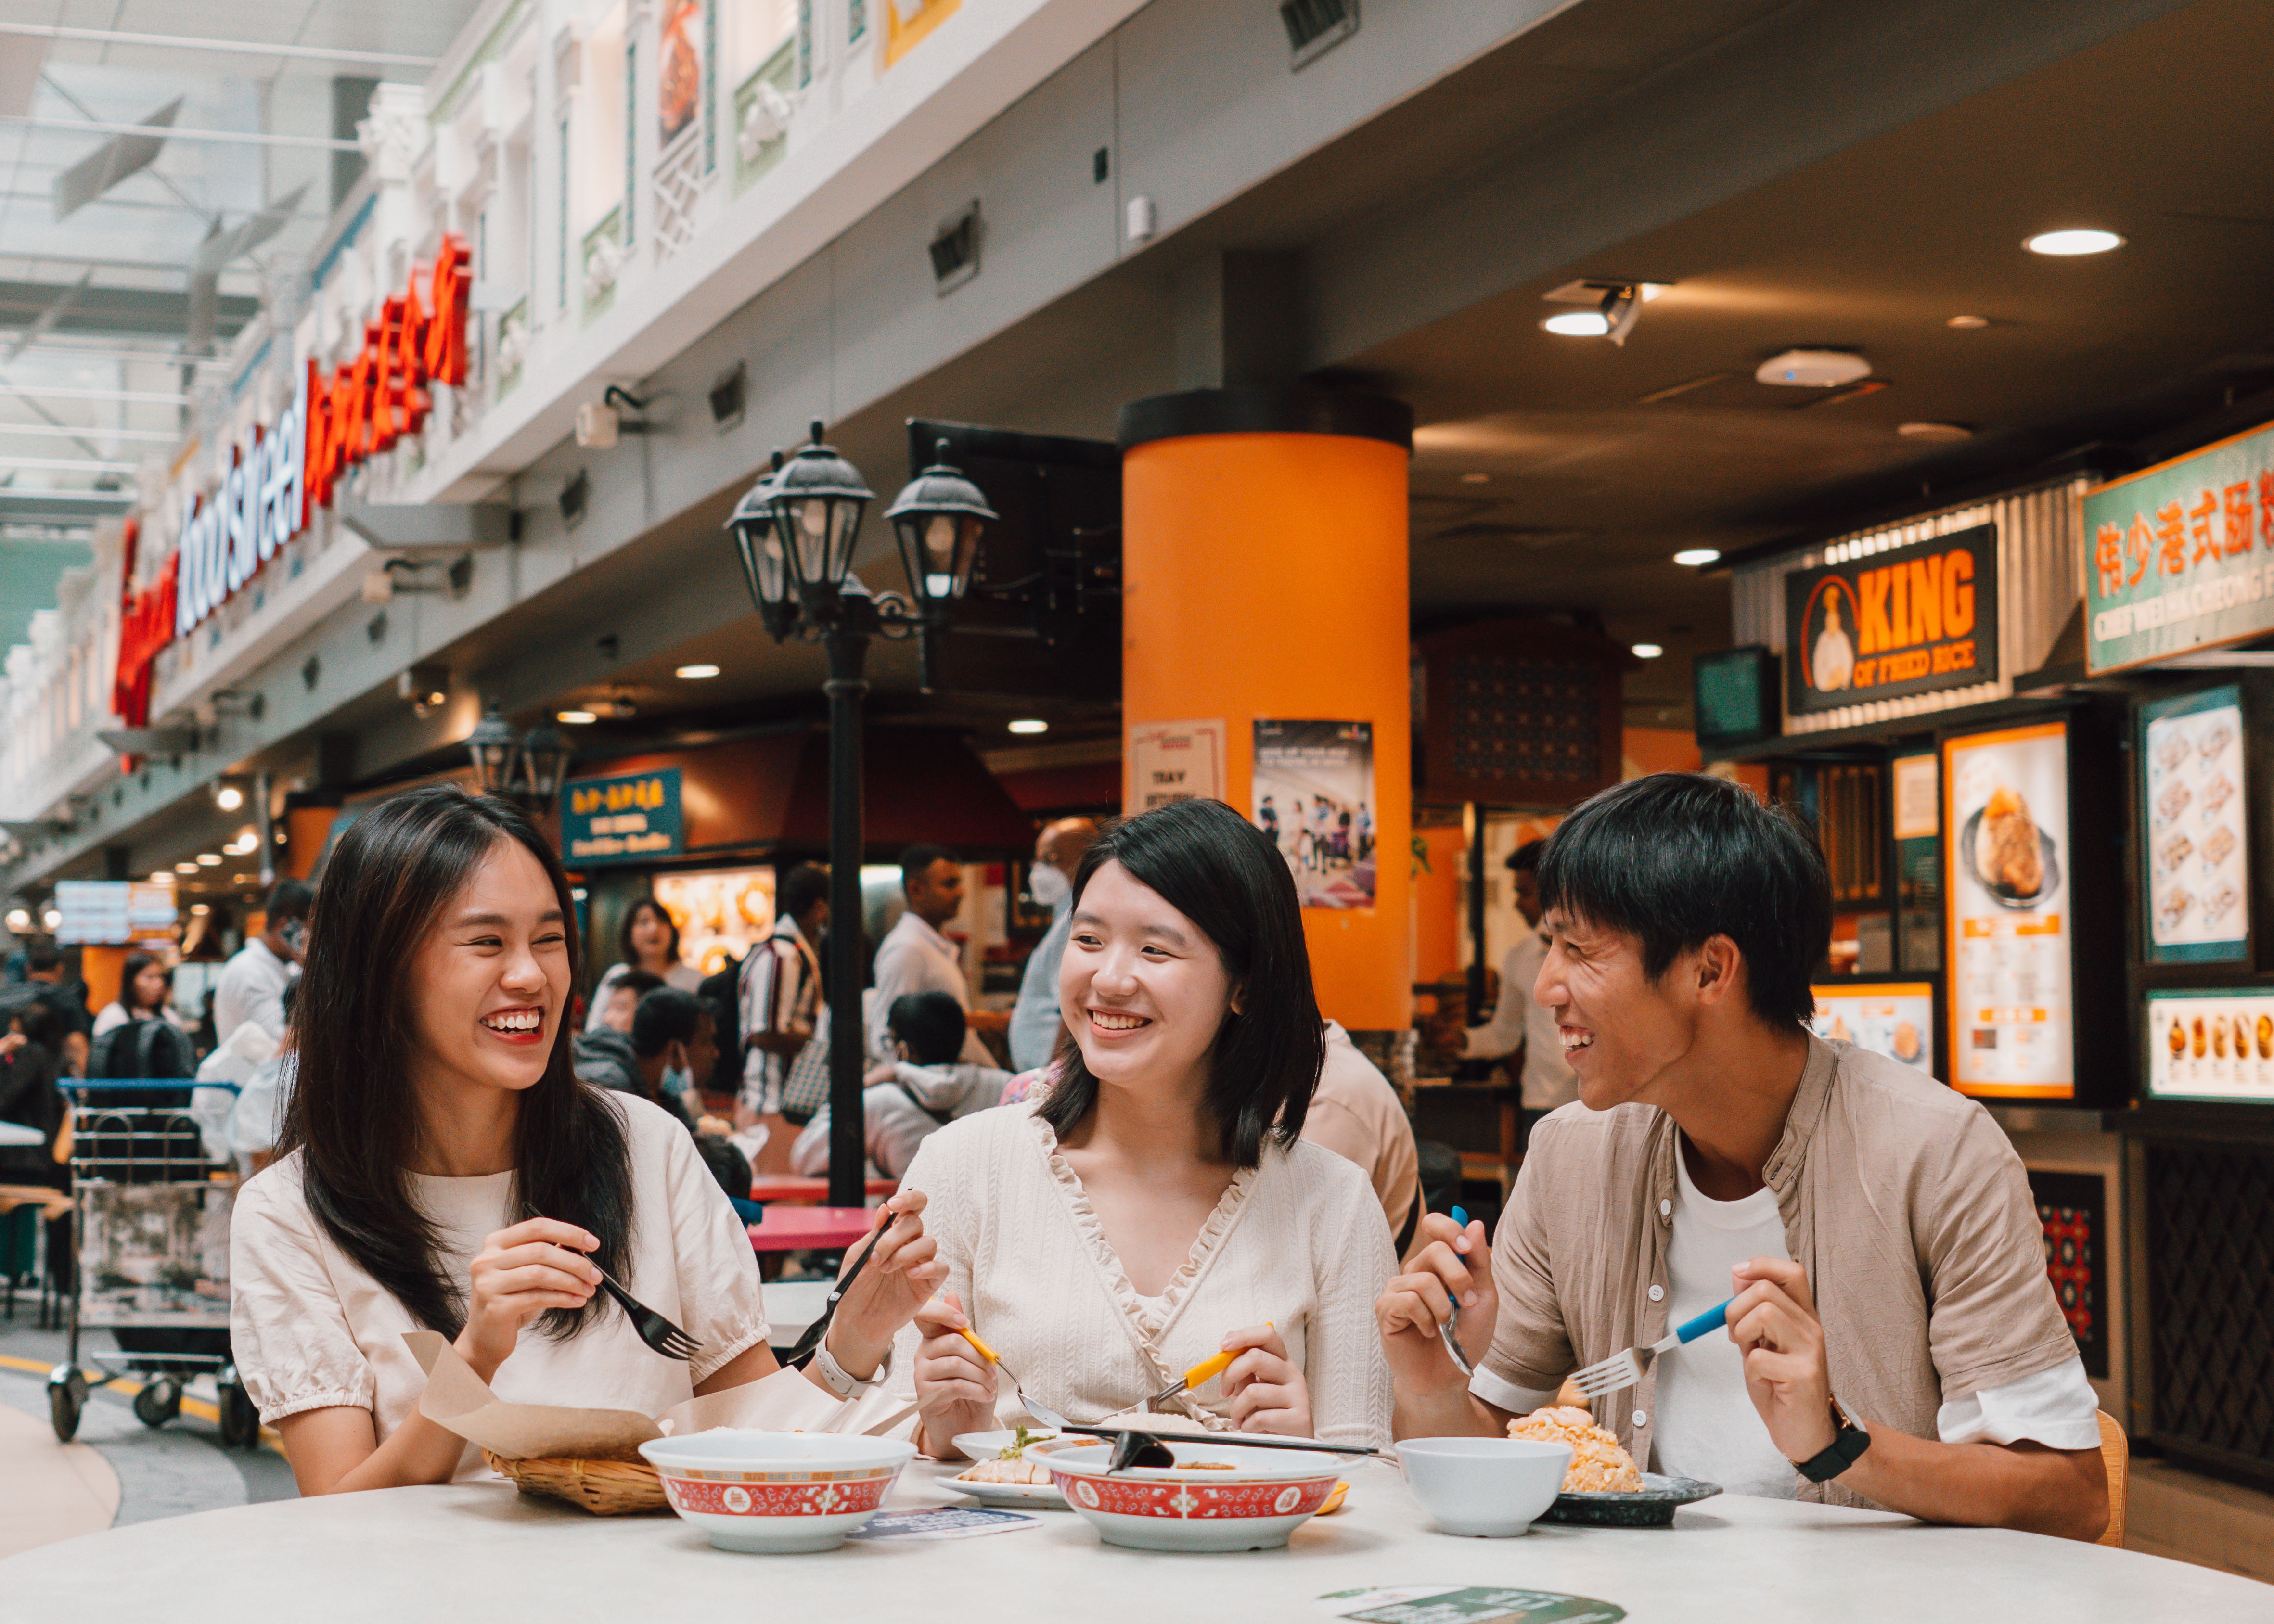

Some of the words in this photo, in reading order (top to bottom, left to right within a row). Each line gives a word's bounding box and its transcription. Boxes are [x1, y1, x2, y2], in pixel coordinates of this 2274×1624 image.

[1858, 548, 1975, 655] KING
[1853, 659, 1878, 689] OF
[1878, 649, 1931, 684] FRIED
[1932, 639, 1976, 675] RICE
